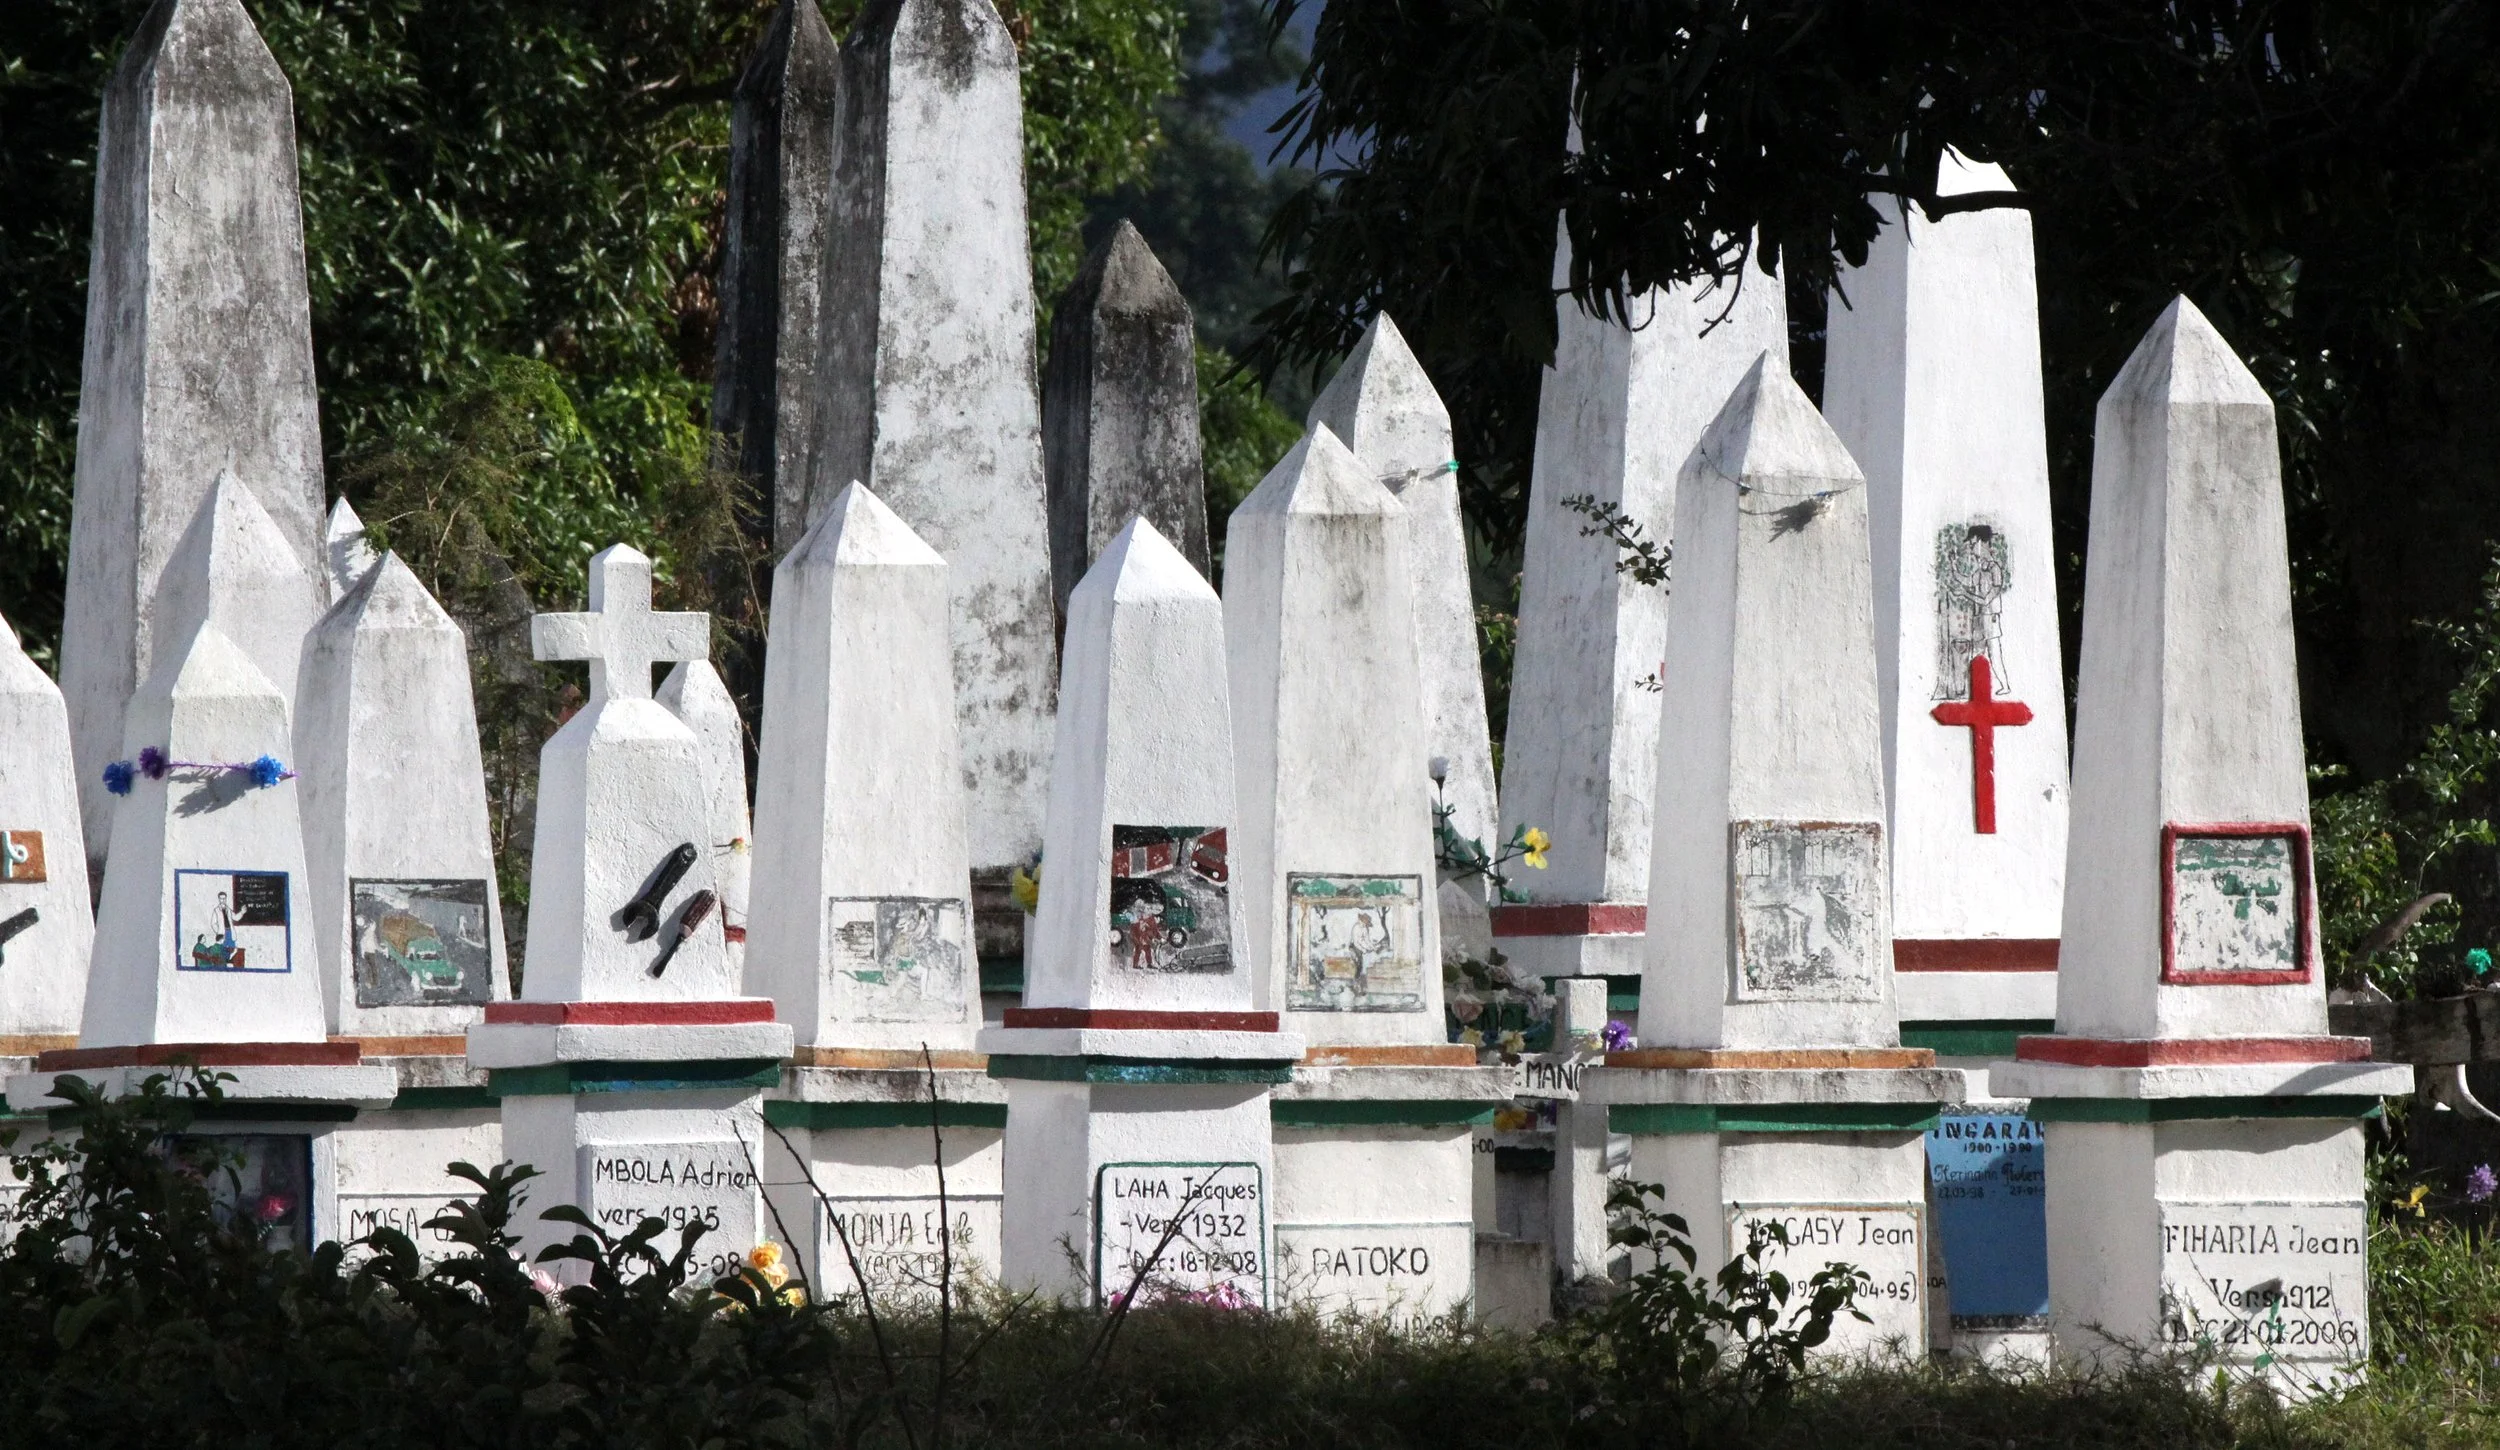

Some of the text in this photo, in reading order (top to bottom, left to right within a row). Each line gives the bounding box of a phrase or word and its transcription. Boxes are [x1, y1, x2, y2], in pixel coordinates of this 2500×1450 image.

[596, 1158, 757, 1190] MBOLA Adrien
[1114, 1176, 1257, 1212] LAHA Jacques
[351, 1208, 419, 1241] MOSA
[598, 1207, 646, 1227] vers
[826, 1212, 914, 1248] MONJA
[1193, 1213, 1246, 1238] 1932
[1858, 1217, 1913, 1246] Jean
[2165, 1225, 2360, 1254] FIHARIA Jean
[1312, 1246, 1429, 1277] RATOKO
[2210, 1278, 2277, 1307] Vers
